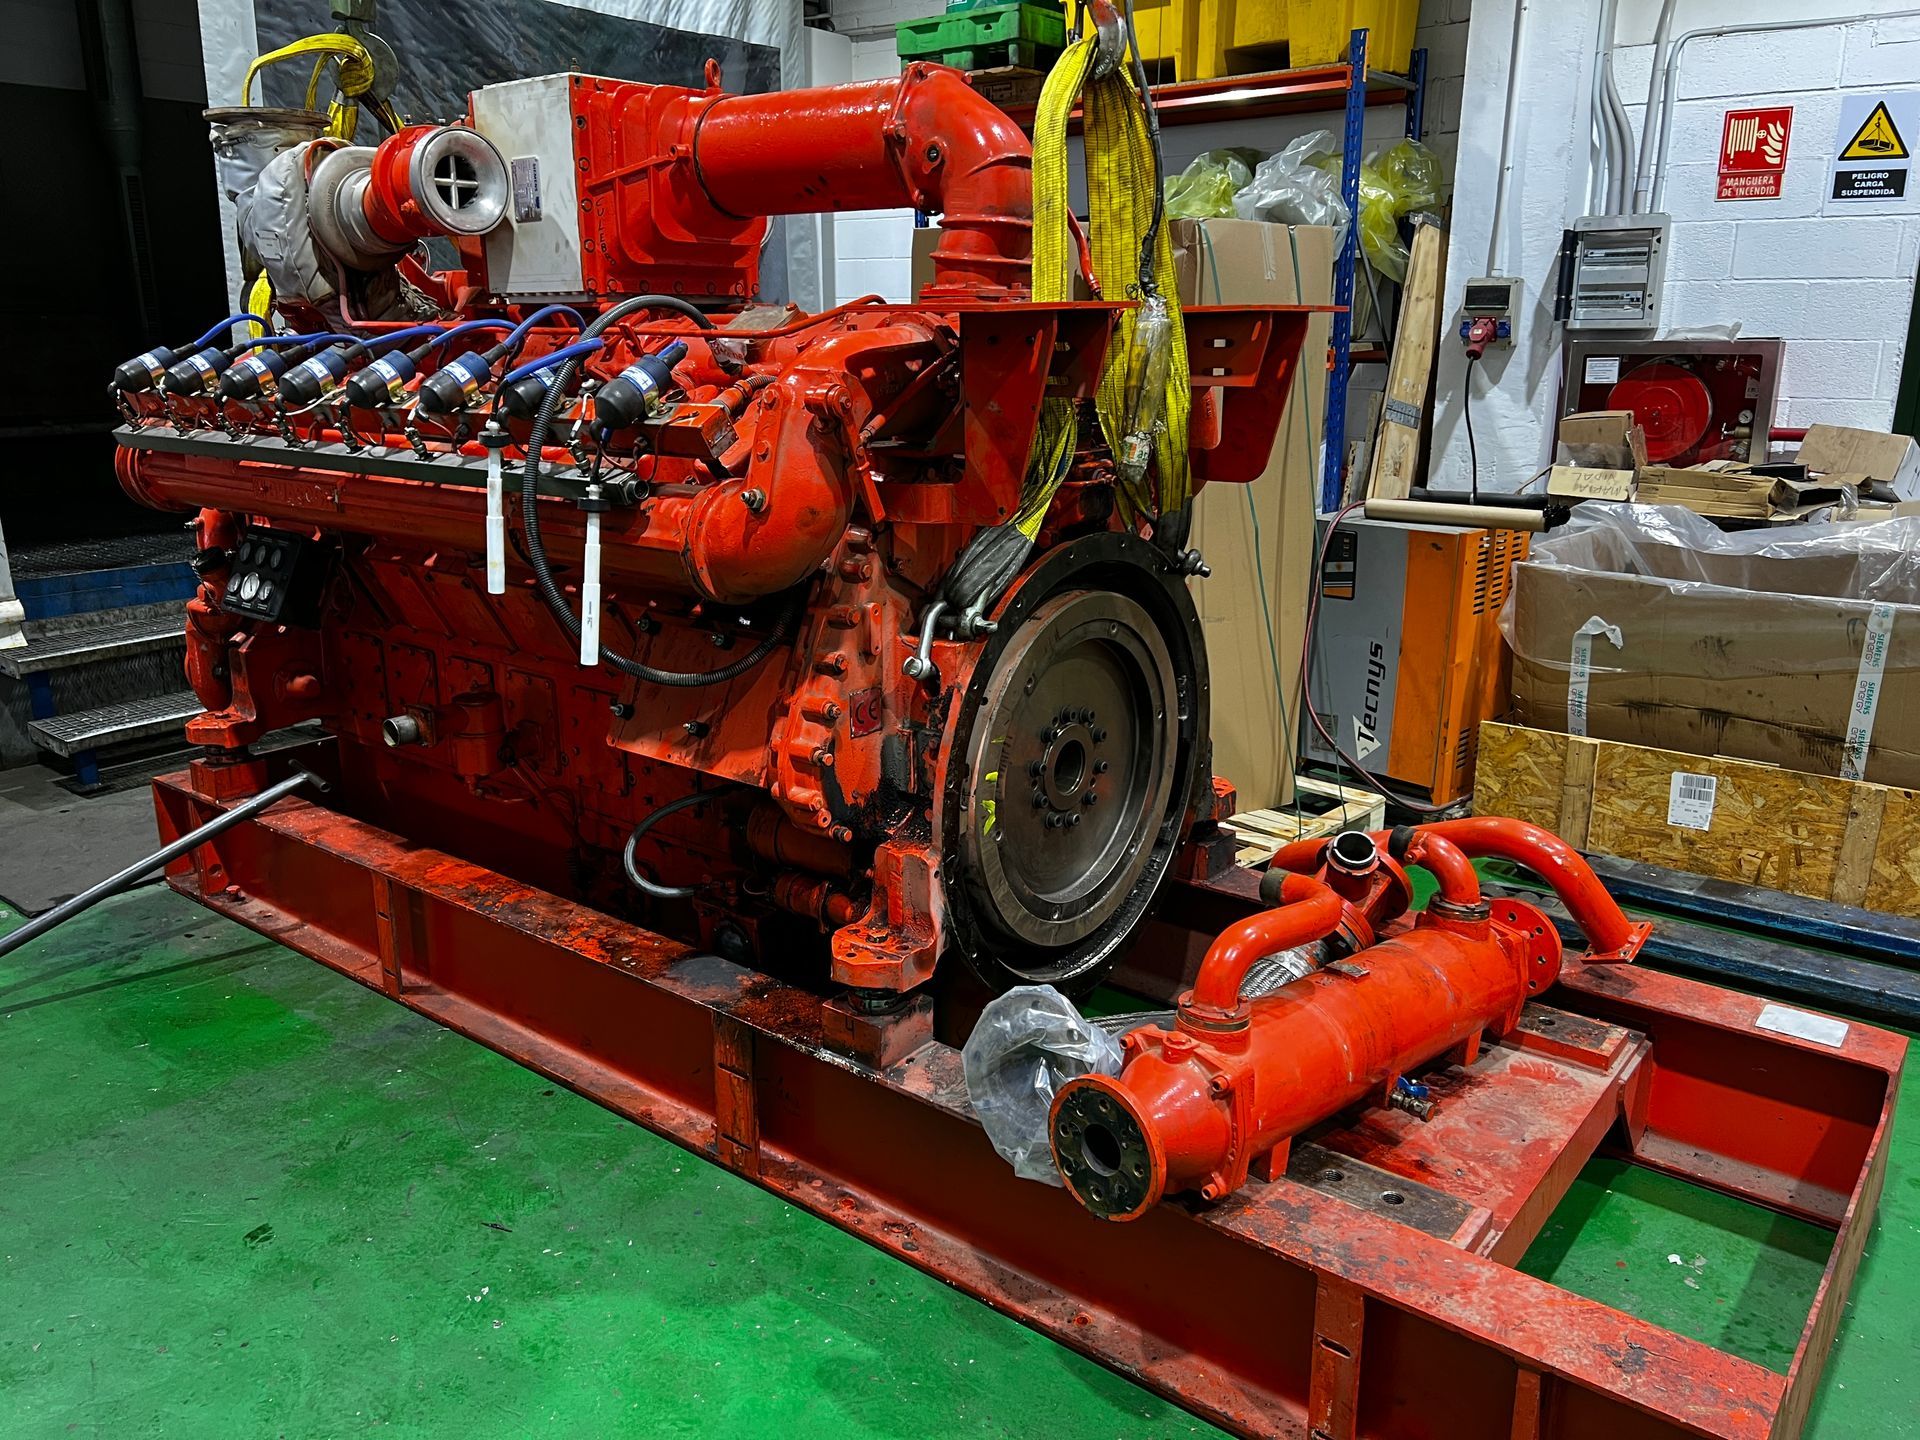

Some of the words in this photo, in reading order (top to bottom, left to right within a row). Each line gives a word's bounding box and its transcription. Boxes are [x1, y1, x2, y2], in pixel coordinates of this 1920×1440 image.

[1725, 175, 1774, 187] MANGUERA
[1852, 172, 1889, 180] PELIGRO
[1721, 188, 1732, 197] DE
[1735, 185, 1775, 196] INCENDIO
[1840, 188, 1895, 197] SUSPENDIDA
[1872, 632, 1885, 669] SIEMENS
[1357, 641, 1386, 743] Tecnys
[1862, 681, 1876, 716] SIEMENS
